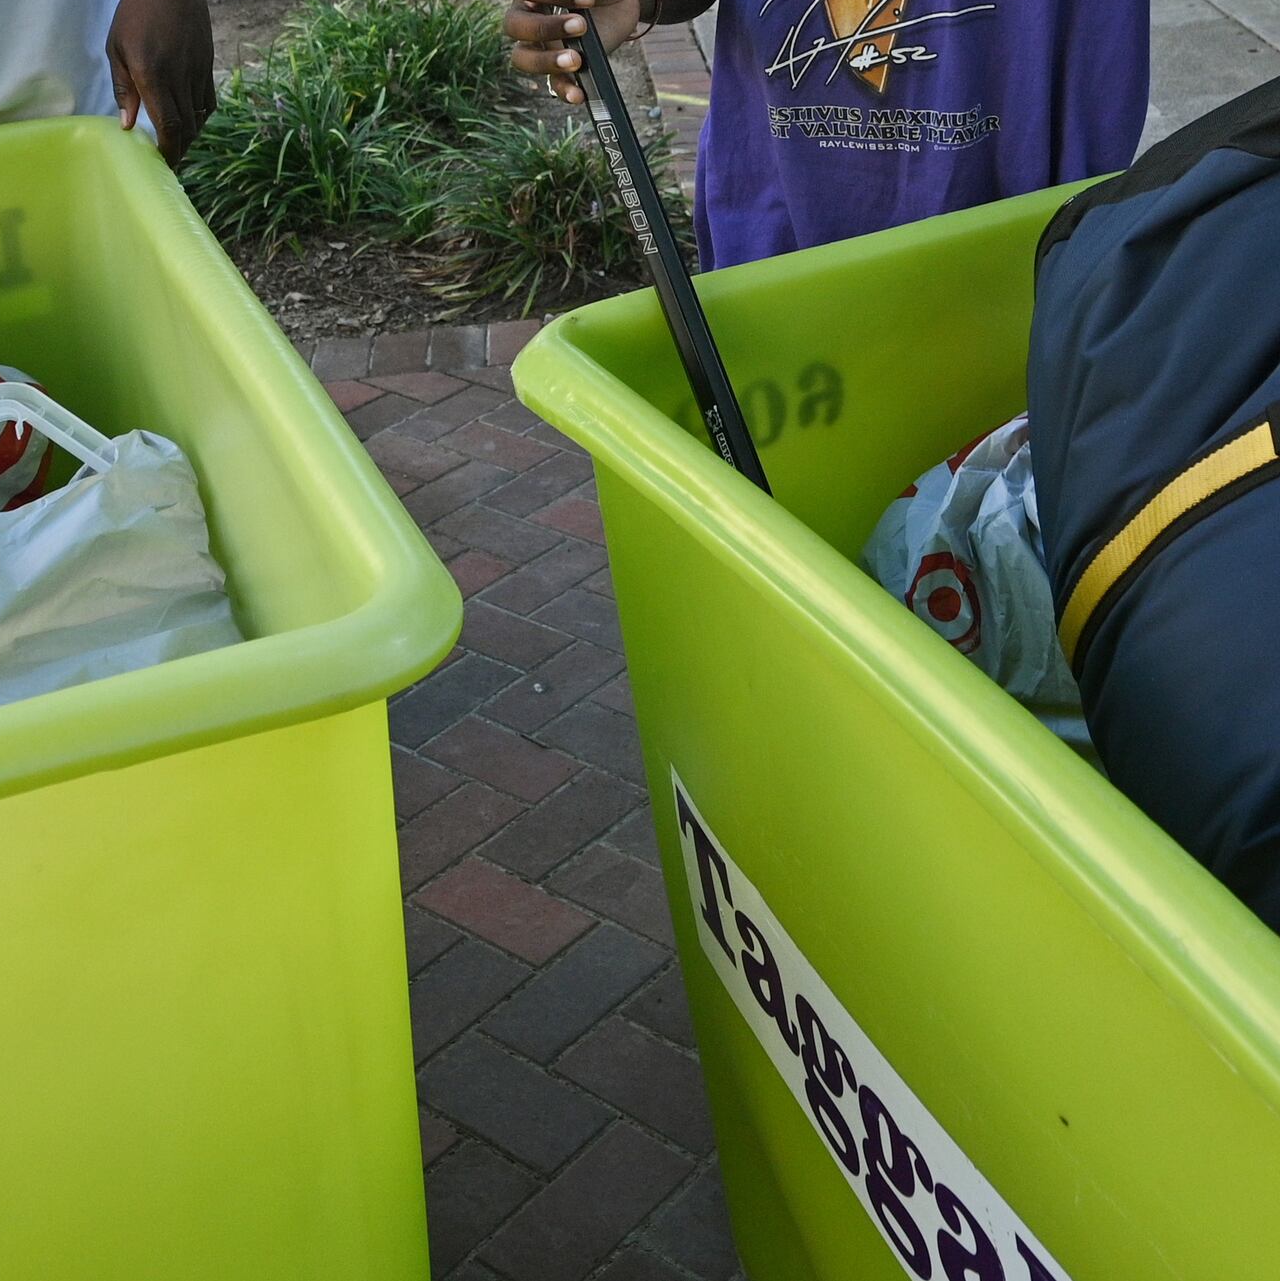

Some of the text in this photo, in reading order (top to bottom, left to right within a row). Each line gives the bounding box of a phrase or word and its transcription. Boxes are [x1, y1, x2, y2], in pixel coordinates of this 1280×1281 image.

[767, 104, 862, 123] ESTIVUS
[797, 121, 922, 142] VALUABLE
[926, 115, 1001, 145] PLAYER
[819, 140, 920, 153] RAYLEWIS52.COM
[597, 121, 659, 255] CARBON
